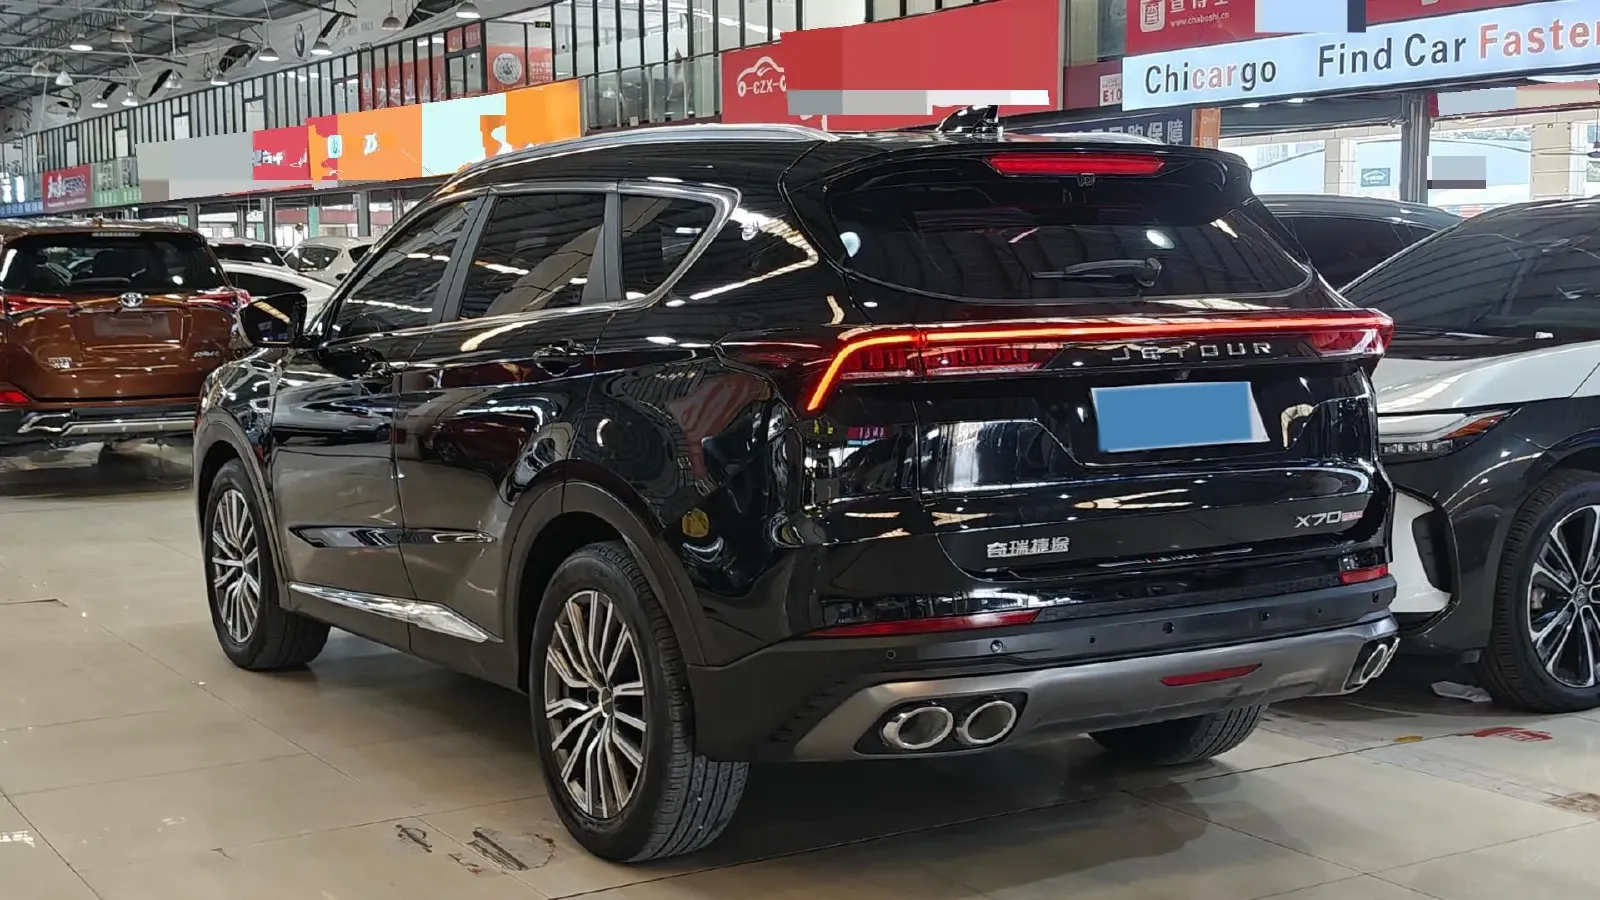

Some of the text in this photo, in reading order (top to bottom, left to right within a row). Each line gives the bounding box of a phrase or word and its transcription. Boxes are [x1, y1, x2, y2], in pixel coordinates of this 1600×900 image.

[1170, 12, 1230, 28] www.chaboshi.cn
[1145, 18, 1600, 95] Chicargo Find Car Faste
[1111, 342, 1272, 361] JETOUR
[1294, 510, 1342, 528] X70
